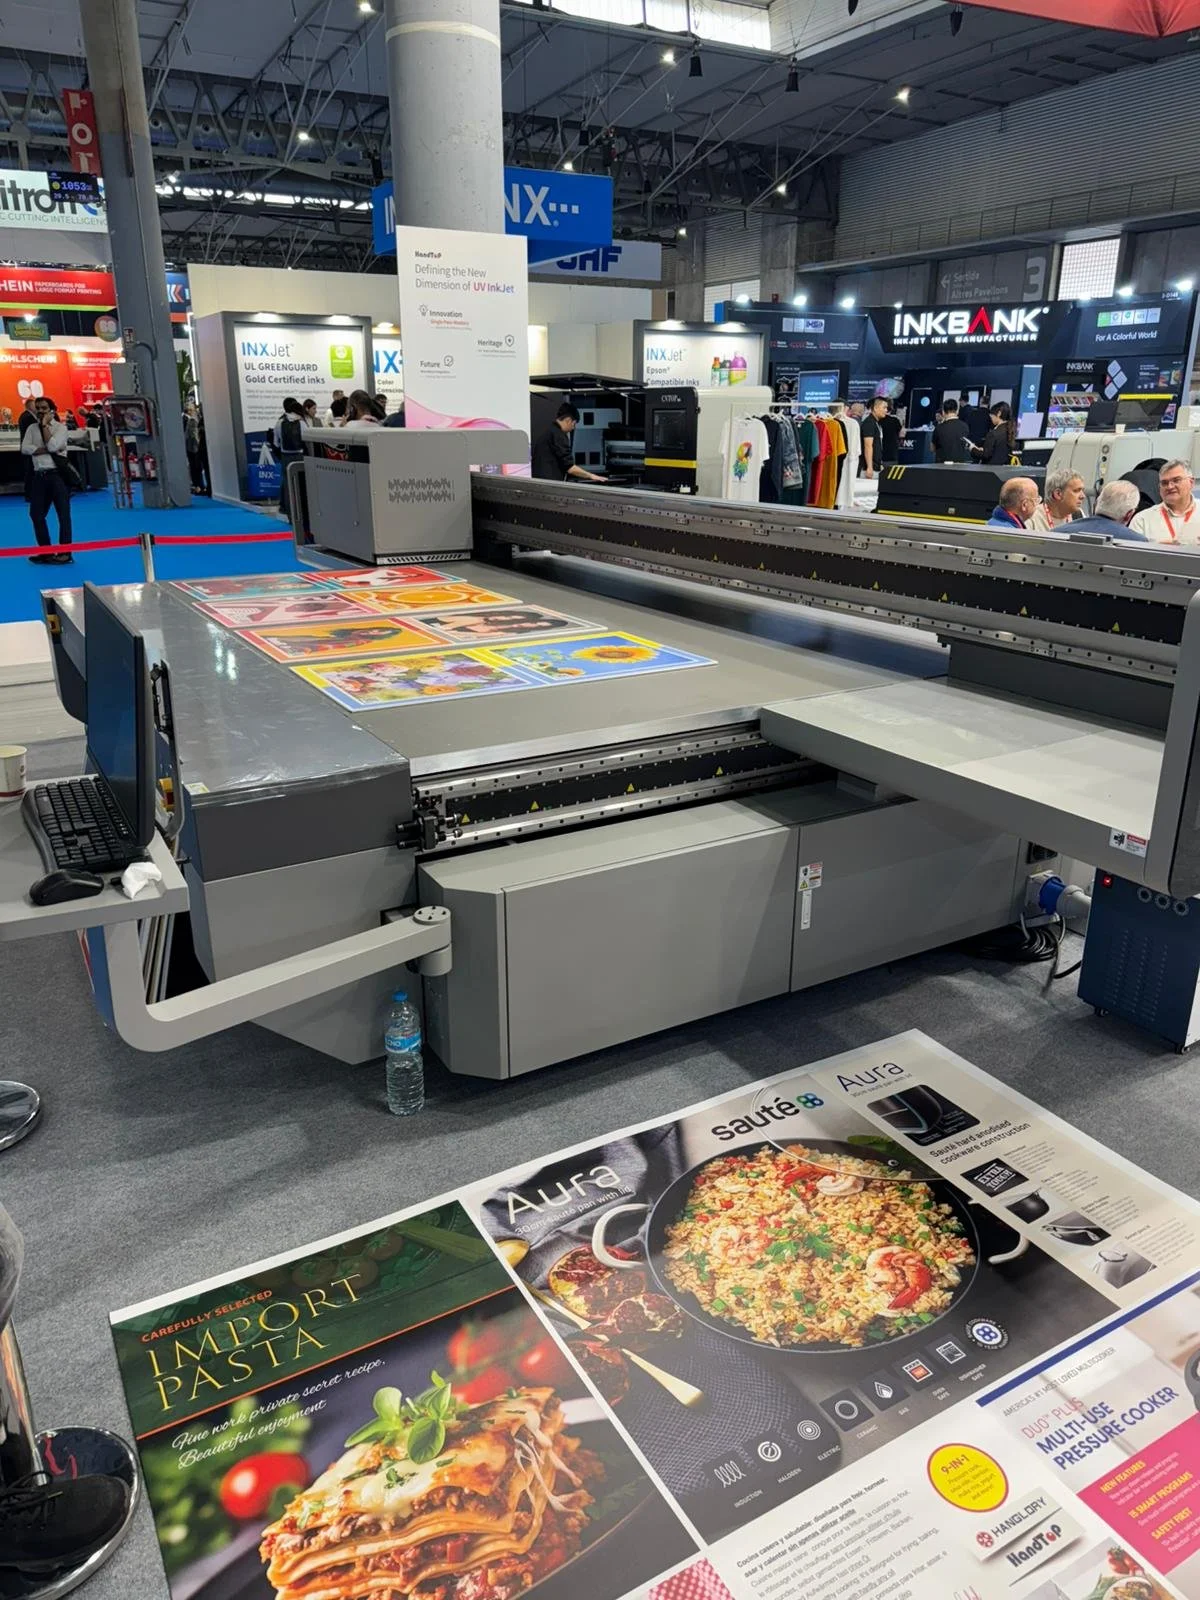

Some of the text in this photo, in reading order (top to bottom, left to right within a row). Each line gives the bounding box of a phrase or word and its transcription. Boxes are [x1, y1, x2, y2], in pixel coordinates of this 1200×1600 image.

[415, 264, 487, 279] Defining the New
[415, 278, 461, 290] Dimension
[462, 281, 471, 290] of
[473, 282, 486, 292] UV
[1023, 257, 1046, 303] 3
[429, 310, 463, 318] Innovation
[894, 306, 1042, 336] INKBANK
[477, 339, 503, 348] Heritage
[893, 333, 1038, 345] INKJET INK MANUFACTURER
[1096, 334, 1106, 342] For
[1112, 332, 1137, 341] Colorful
[1138, 330, 1158, 339] World
[244, 362, 318, 372] UL GREENGUARD
[420, 360, 440, 368] Future
[245, 374, 326, 385] Gold Certified inks
[647, 378, 700, 387] Compatible Inks
[836, 1062, 904, 1092] Aura
[711, 1096, 800, 1142] sauté
[955, 1134, 977, 1148] hard
[975, 1119, 1012, 1139] anodised
[940, 1145, 981, 1165] cookware
[980, 1122, 1031, 1147] construction
[977, 1166, 1005, 1185] EXTRA
[507, 1165, 621, 1225] Aura
[577, 1200, 596, 1214] pan
[598, 1191, 619, 1208] with
[617, 1185, 632, 1197] lid
[141, 1290, 273, 1344] CAREFULLY SELECTED
[146, 1274, 361, 1378] IMPORT
[154, 1326, 331, 1411] PASTA
[1042, 1379, 1059, 1394] MOST
[1058, 1369, 1077, 1384] LOVED
[172, 1429, 209, 1451] Fine
[211, 1414, 248, 1435] work
[249, 1393, 300, 1422] private
[302, 1375, 342, 1396] secret
[1051, 1397, 1085, 1422] PLUS
[178, 1400, 328, 1470] Beautiful enjoyment
[1036, 1401, 1114, 1454] MULTI-USE
[1053, 1386, 1180, 1470] PRESSURE COOKER
[817, 1445, 841, 1461] ELECTRIC
[1099, 1459, 1146, 1493] NEW FEATURES
[1135, 1494, 1159, 1513] SMART
[1155, 1470, 1193, 1499] PROGRAMS
[991, 1497, 1047, 1537] HANGLORY
[1151, 1519, 1177, 1540] SAFETY
[1174, 1507, 1192, 1524] FIRST
[736, 1550, 759, 1568] Cocina
